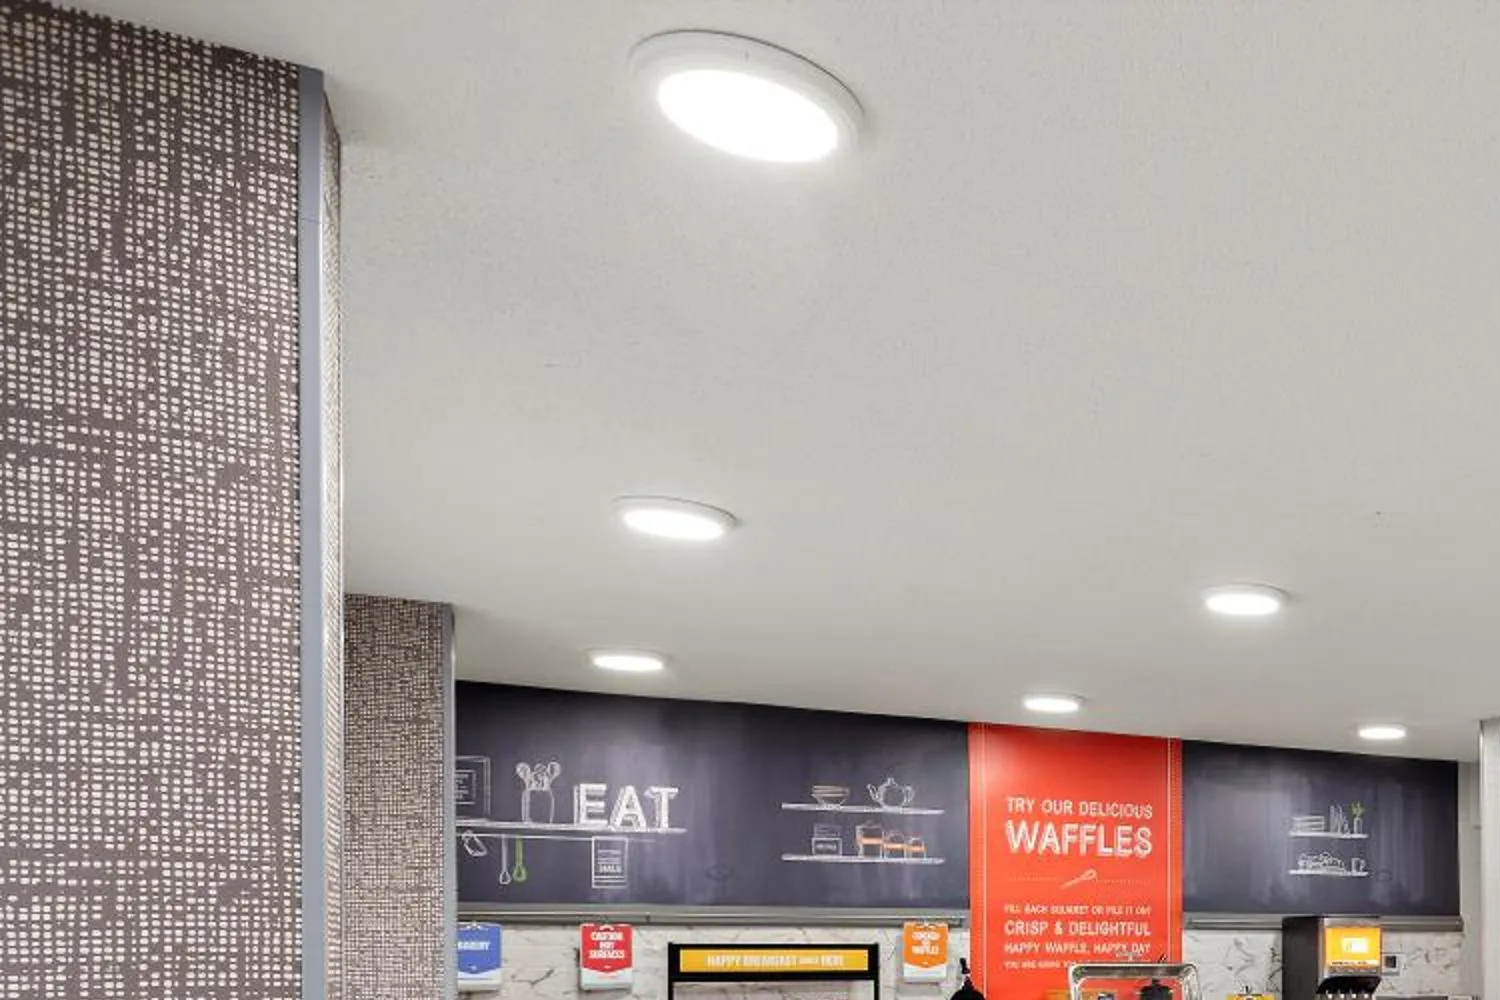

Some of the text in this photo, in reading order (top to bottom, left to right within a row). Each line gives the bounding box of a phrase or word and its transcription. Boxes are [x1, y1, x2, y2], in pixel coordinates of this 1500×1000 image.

[573, 783, 679, 832] EAT
[1006, 796, 1153, 819] TRY OUR DELICIOUS
[1005, 819, 1153, 858] WAFFLES
[1003, 919, 1151, 937] CRISP & DELIGHTFUL
[1003, 942, 1040, 954] HAPPY
[1093, 942, 1128, 954] HAPPY
[1131, 943, 1151, 955] DAY
